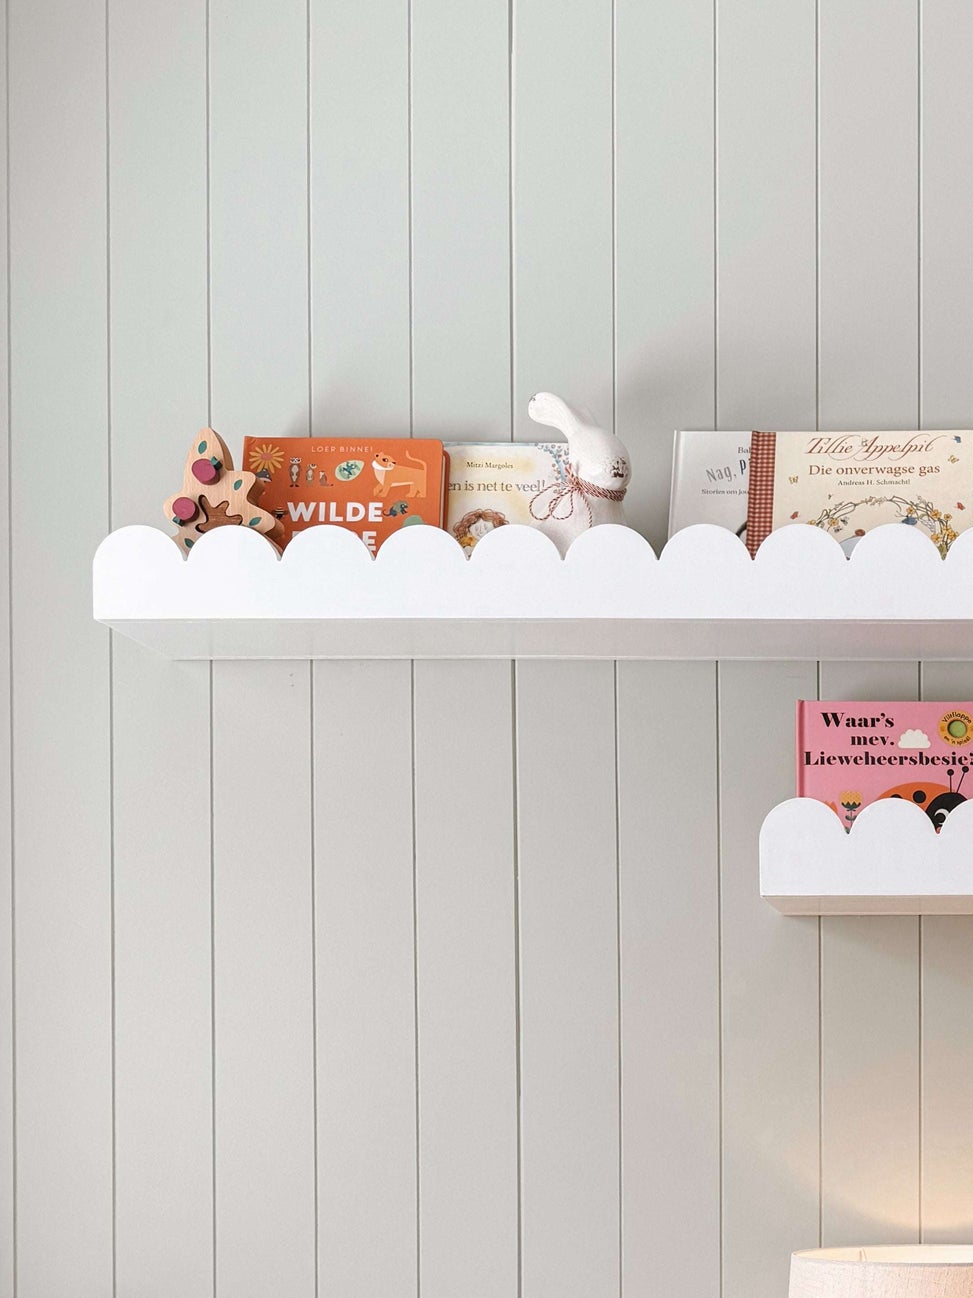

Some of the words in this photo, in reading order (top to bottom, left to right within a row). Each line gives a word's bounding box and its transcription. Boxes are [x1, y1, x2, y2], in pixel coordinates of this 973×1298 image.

[805, 435, 857, 460] Tillie
[809, 465, 832, 476] Die
[836, 464, 915, 477] onverwagse
[919, 464, 941, 476] gas
[464, 480, 474, 492] is
[477, 481, 498, 492] net
[501, 481, 513, 492] te
[515, 479, 545, 492] veel!
[876, 478, 911, 486] Schmachtl
[287, 501, 384, 522] WILDE
[820, 712, 895, 728] Waar's
[850, 735, 895, 746] mev.
